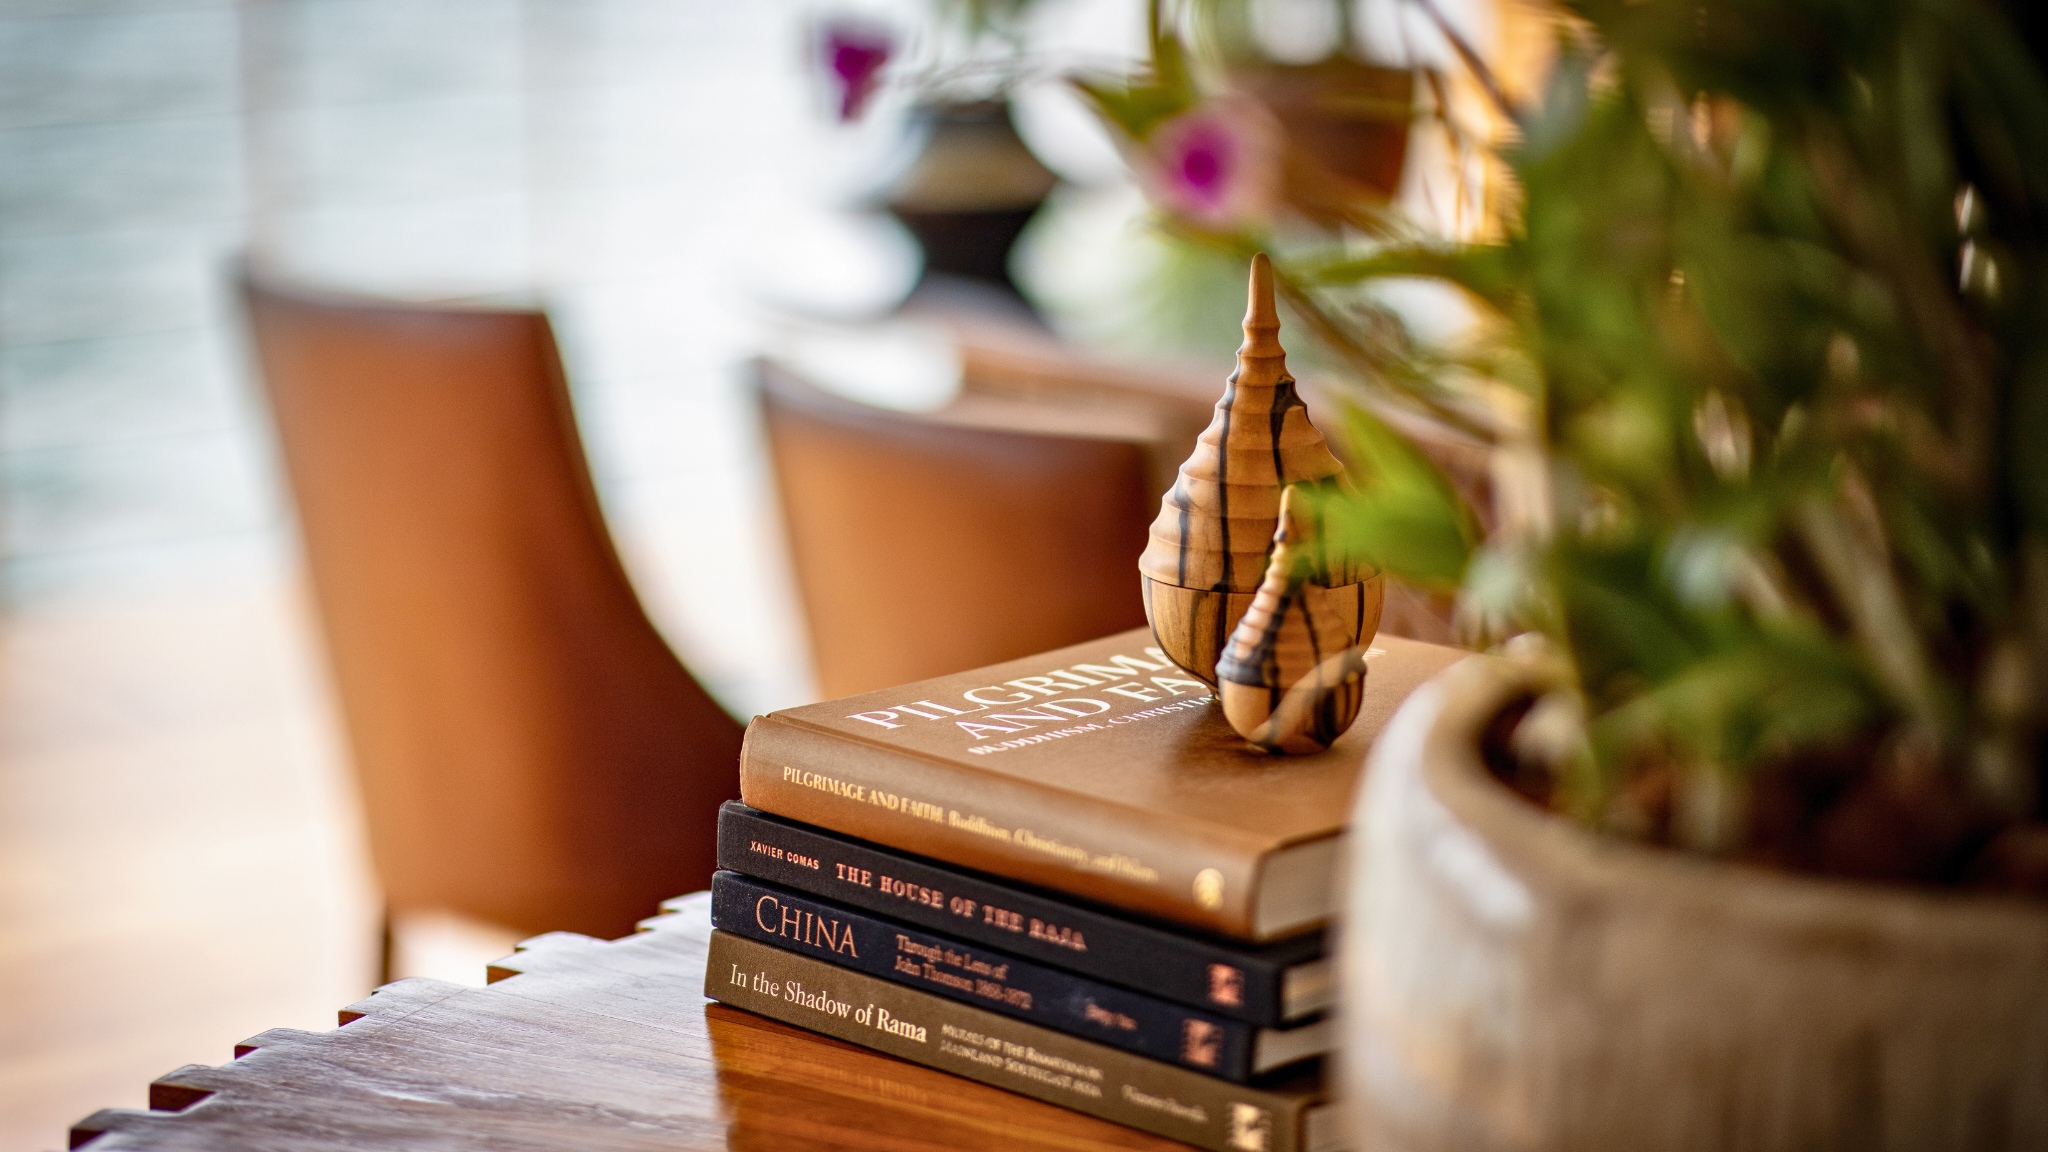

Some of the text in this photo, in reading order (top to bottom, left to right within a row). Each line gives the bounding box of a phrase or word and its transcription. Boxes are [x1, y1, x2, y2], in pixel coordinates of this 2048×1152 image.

[955, 669, 1206, 740] AND FA
[967, 723, 1113, 755] BUDDHISM,
[783, 766, 866, 802] PILGRIMAGE
[868, 790, 899, 811] AND
[750, 840, 820, 870] XAVIER COMAS
[756, 895, 859, 959] CHINA
[835, 863, 872, 888] THE
[879, 875, 944, 909] HOUSE
[950, 896, 977, 918] OF
[982, 905, 1025, 933] THE
[729, 963, 928, 1043] In the Shadow of Rama
